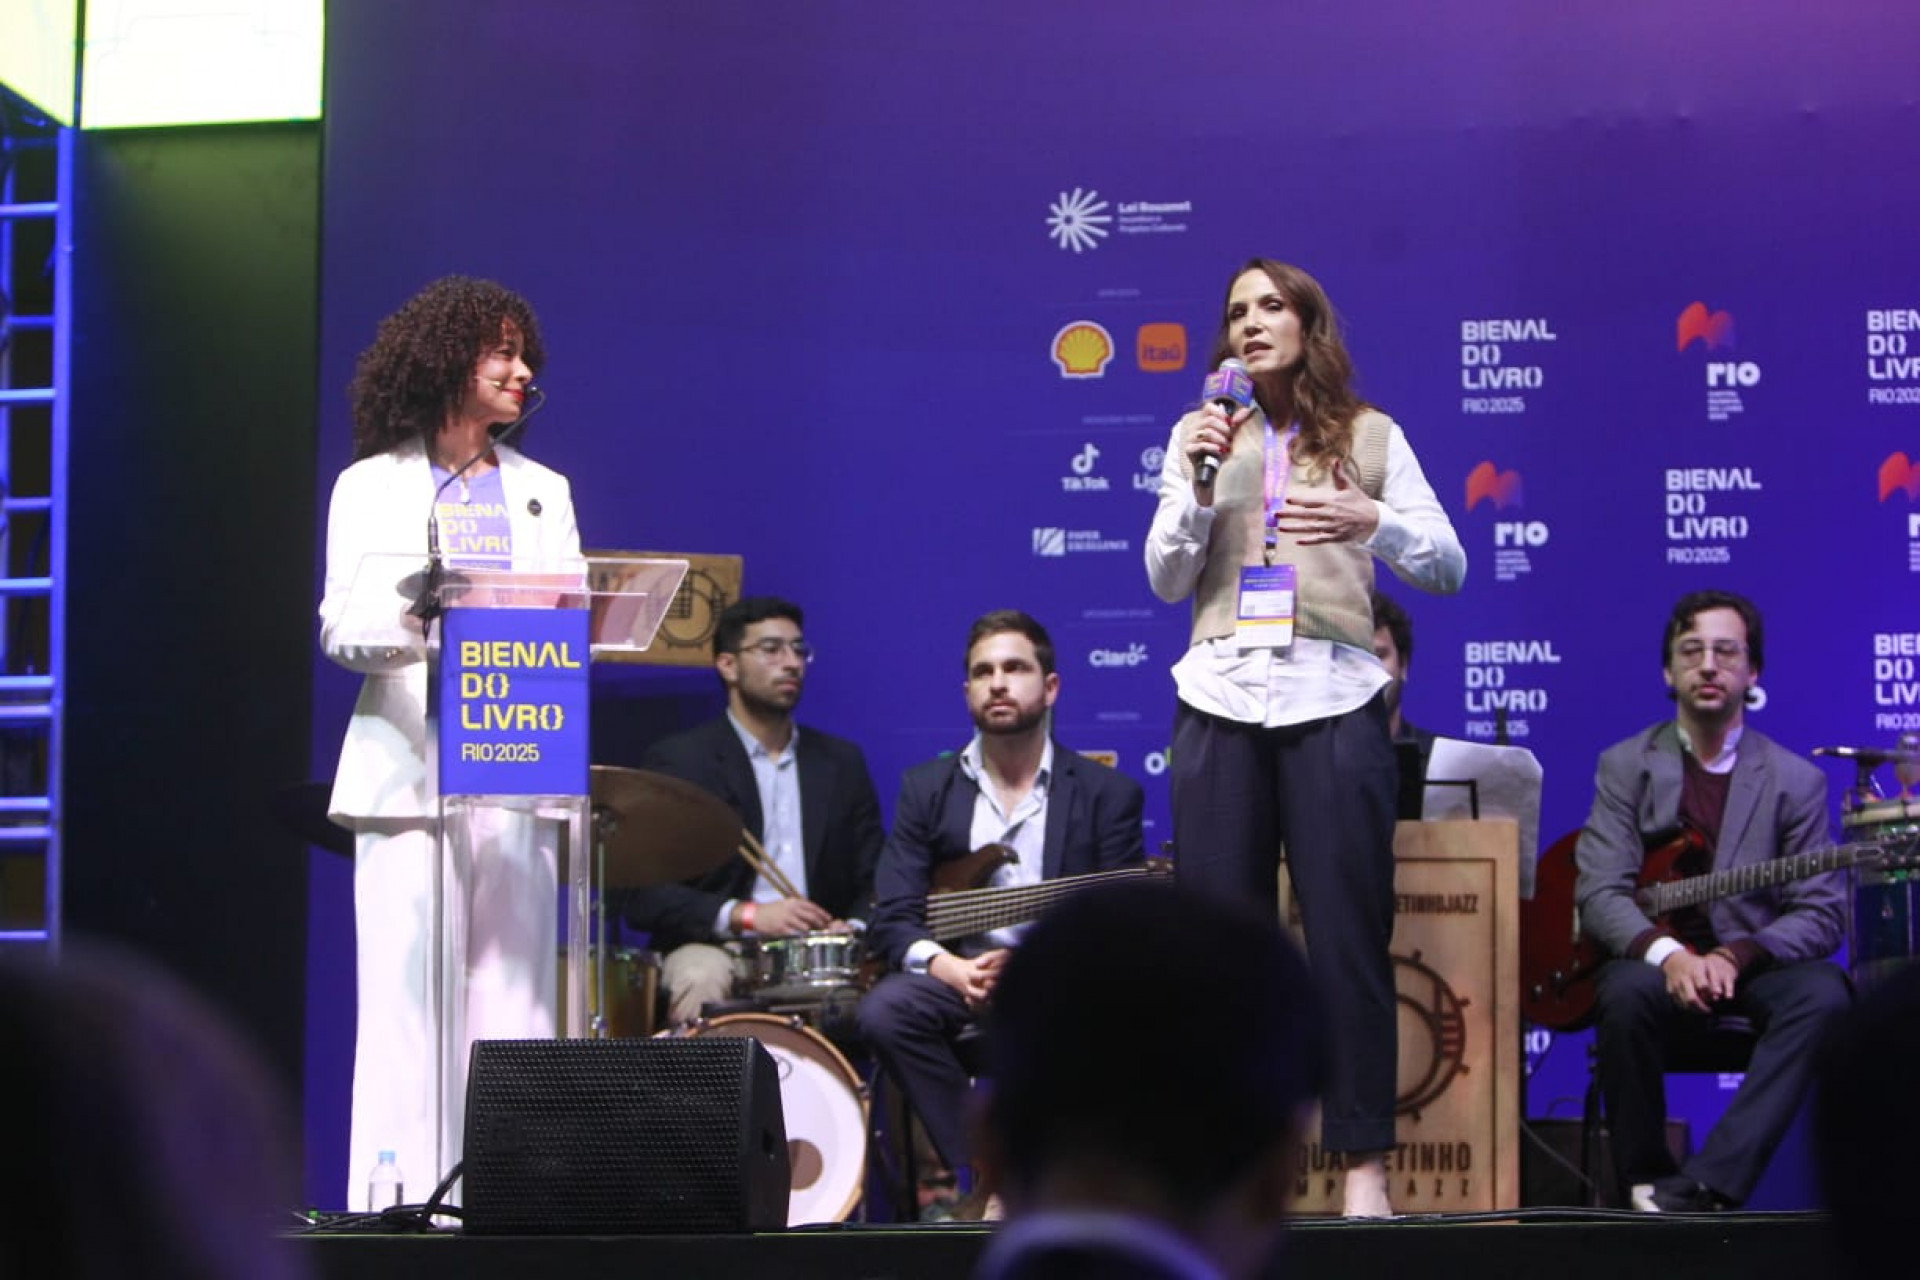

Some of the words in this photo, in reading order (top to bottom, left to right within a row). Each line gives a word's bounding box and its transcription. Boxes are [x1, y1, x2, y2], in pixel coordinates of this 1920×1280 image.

[1461, 318, 1557, 342] BIENAL
[1867, 310, 1920, 331] BIEN
[1461, 344, 1501, 366] DO
[1867, 334, 1907, 356] DO
[1461, 367, 1543, 390] LIVRO
[1868, 357, 1920, 380] LIVR
[1462, 397, 1488, 414] RIO
[1489, 396, 1525, 413] 2025
[1896, 387, 1920, 403] 202
[1666, 467, 1762, 491] BIENAL
[438, 503, 508, 518] BIENA
[1666, 493, 1706, 516] DO
[1666, 516, 1748, 539] LIVRO
[1667, 547, 1693, 564] RIO
[1694, 546, 1730, 563] 2025
[460, 641, 581, 668] BIENAL
[1465, 640, 1561, 664] BIENAL
[1875, 633, 1920, 656] BIE
[1466, 666, 1505, 689] DO
[1875, 658, 1914, 681] DO
[1466, 689, 1547, 713] LIVRO
[1876, 682, 1920, 705] LIV
[460, 704, 564, 731] LIVRO
[1902, 713, 1920, 729] 20
[461, 743, 493, 762] RIO
[495, 743, 540, 762] 2025
